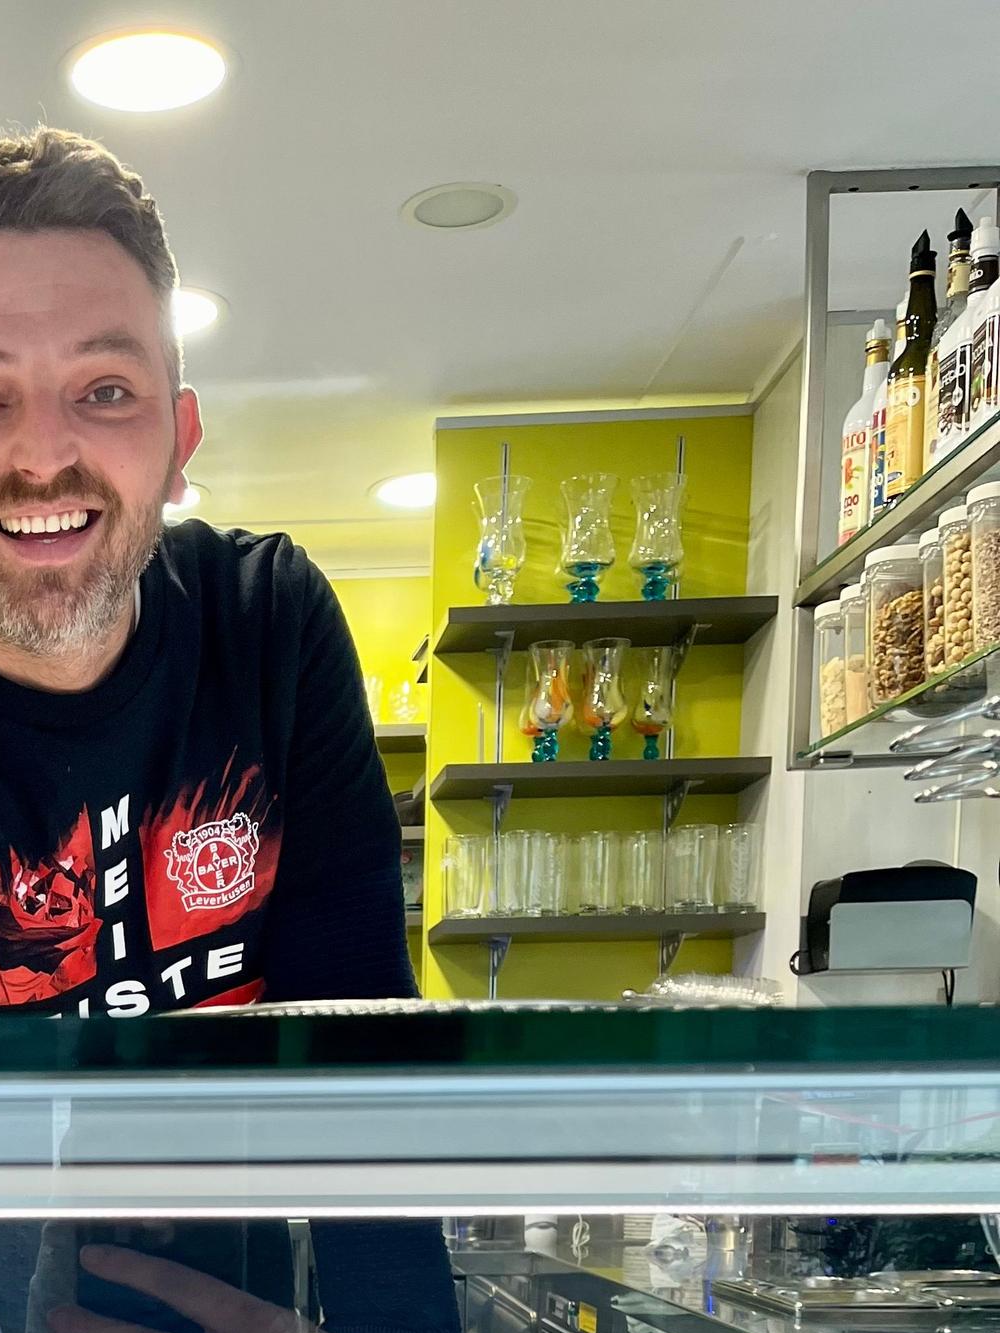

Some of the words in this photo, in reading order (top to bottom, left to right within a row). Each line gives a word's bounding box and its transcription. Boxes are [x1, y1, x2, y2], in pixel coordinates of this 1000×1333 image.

[198, 826, 221, 840] 1904
[198, 856, 238, 875] BAYER
[189, 880, 251, 906] Leverkusen
